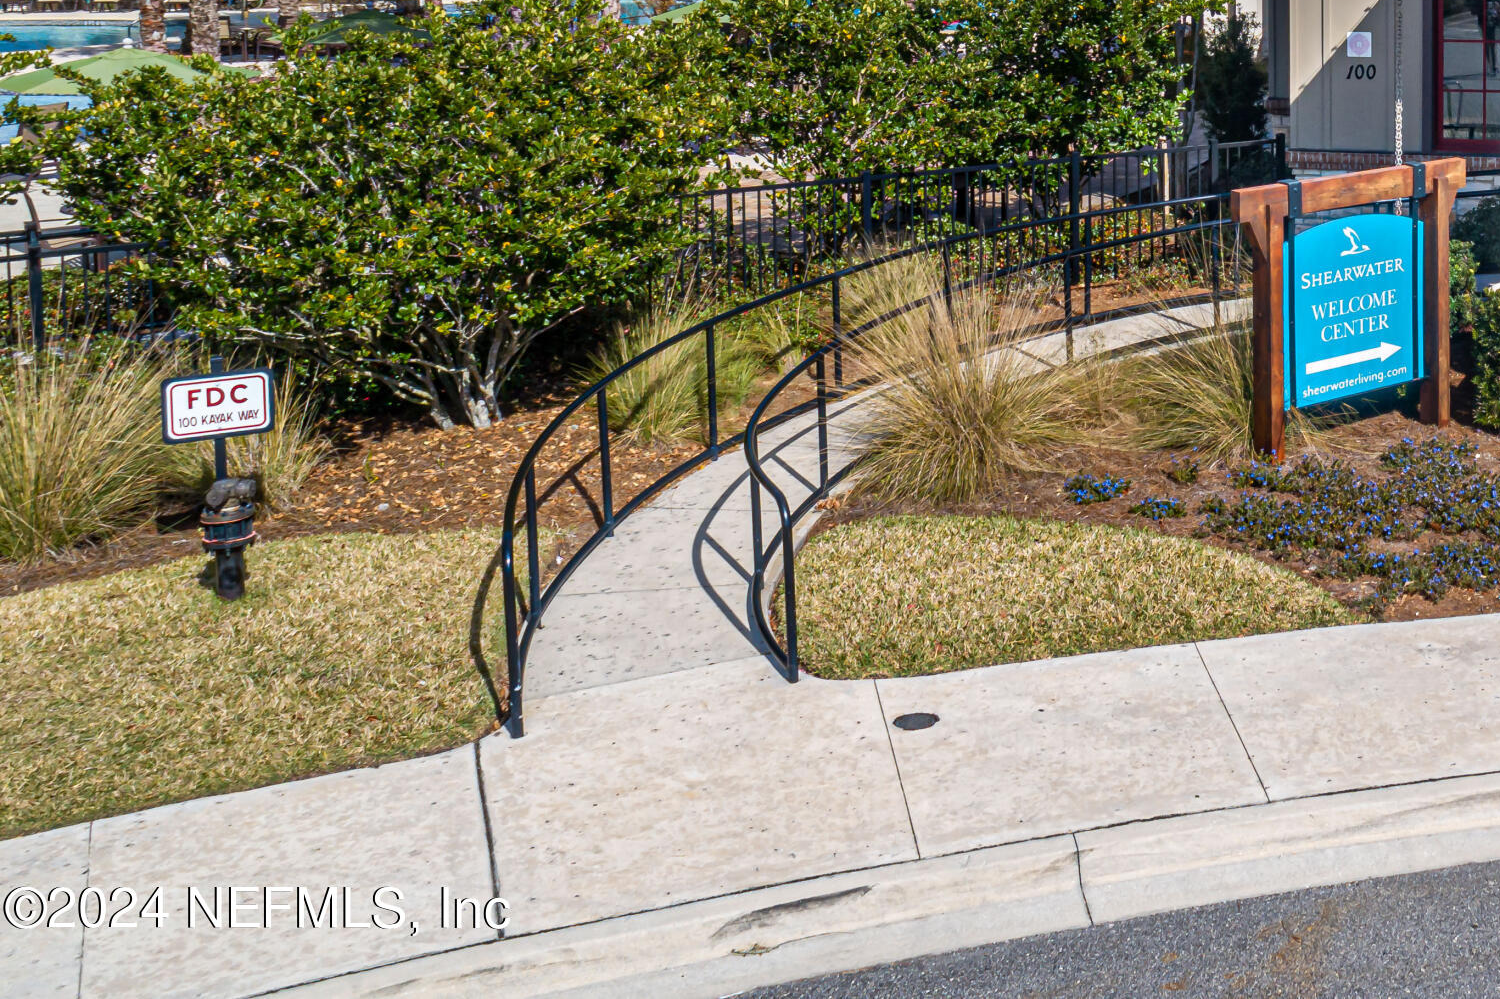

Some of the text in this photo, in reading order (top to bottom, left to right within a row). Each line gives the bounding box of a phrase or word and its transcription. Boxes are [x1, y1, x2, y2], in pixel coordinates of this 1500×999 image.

[1346, 64, 1377, 80] 100
[1301, 258, 1405, 290] SHEARWATER
[1311, 289, 1398, 321] WELCOME
[1320, 313, 1390, 343] CENTER
[1302, 365, 1407, 398] shearwaterliving.com
[187, 384, 249, 410] FDC
[178, 408, 260, 428] 100 KAYAK WAY
